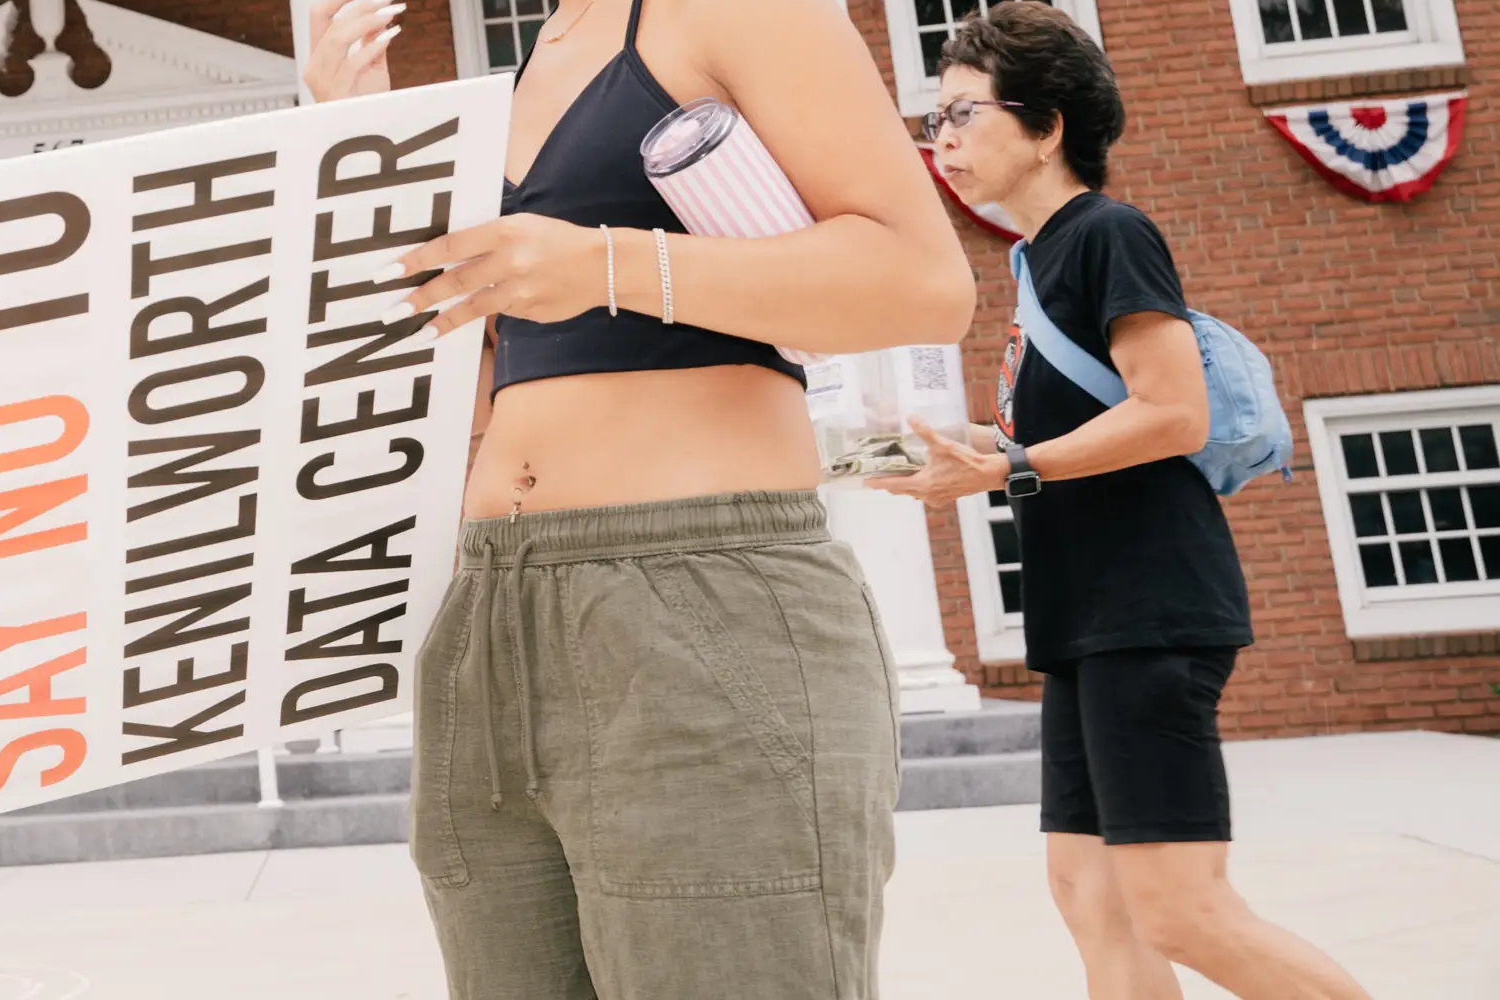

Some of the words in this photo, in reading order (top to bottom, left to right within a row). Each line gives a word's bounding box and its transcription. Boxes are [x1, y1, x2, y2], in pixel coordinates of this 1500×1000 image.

[122, 150, 278, 766] KENILWORTH
[296, 116, 460, 500] CENTER
[280, 515, 417, 727] DATA
